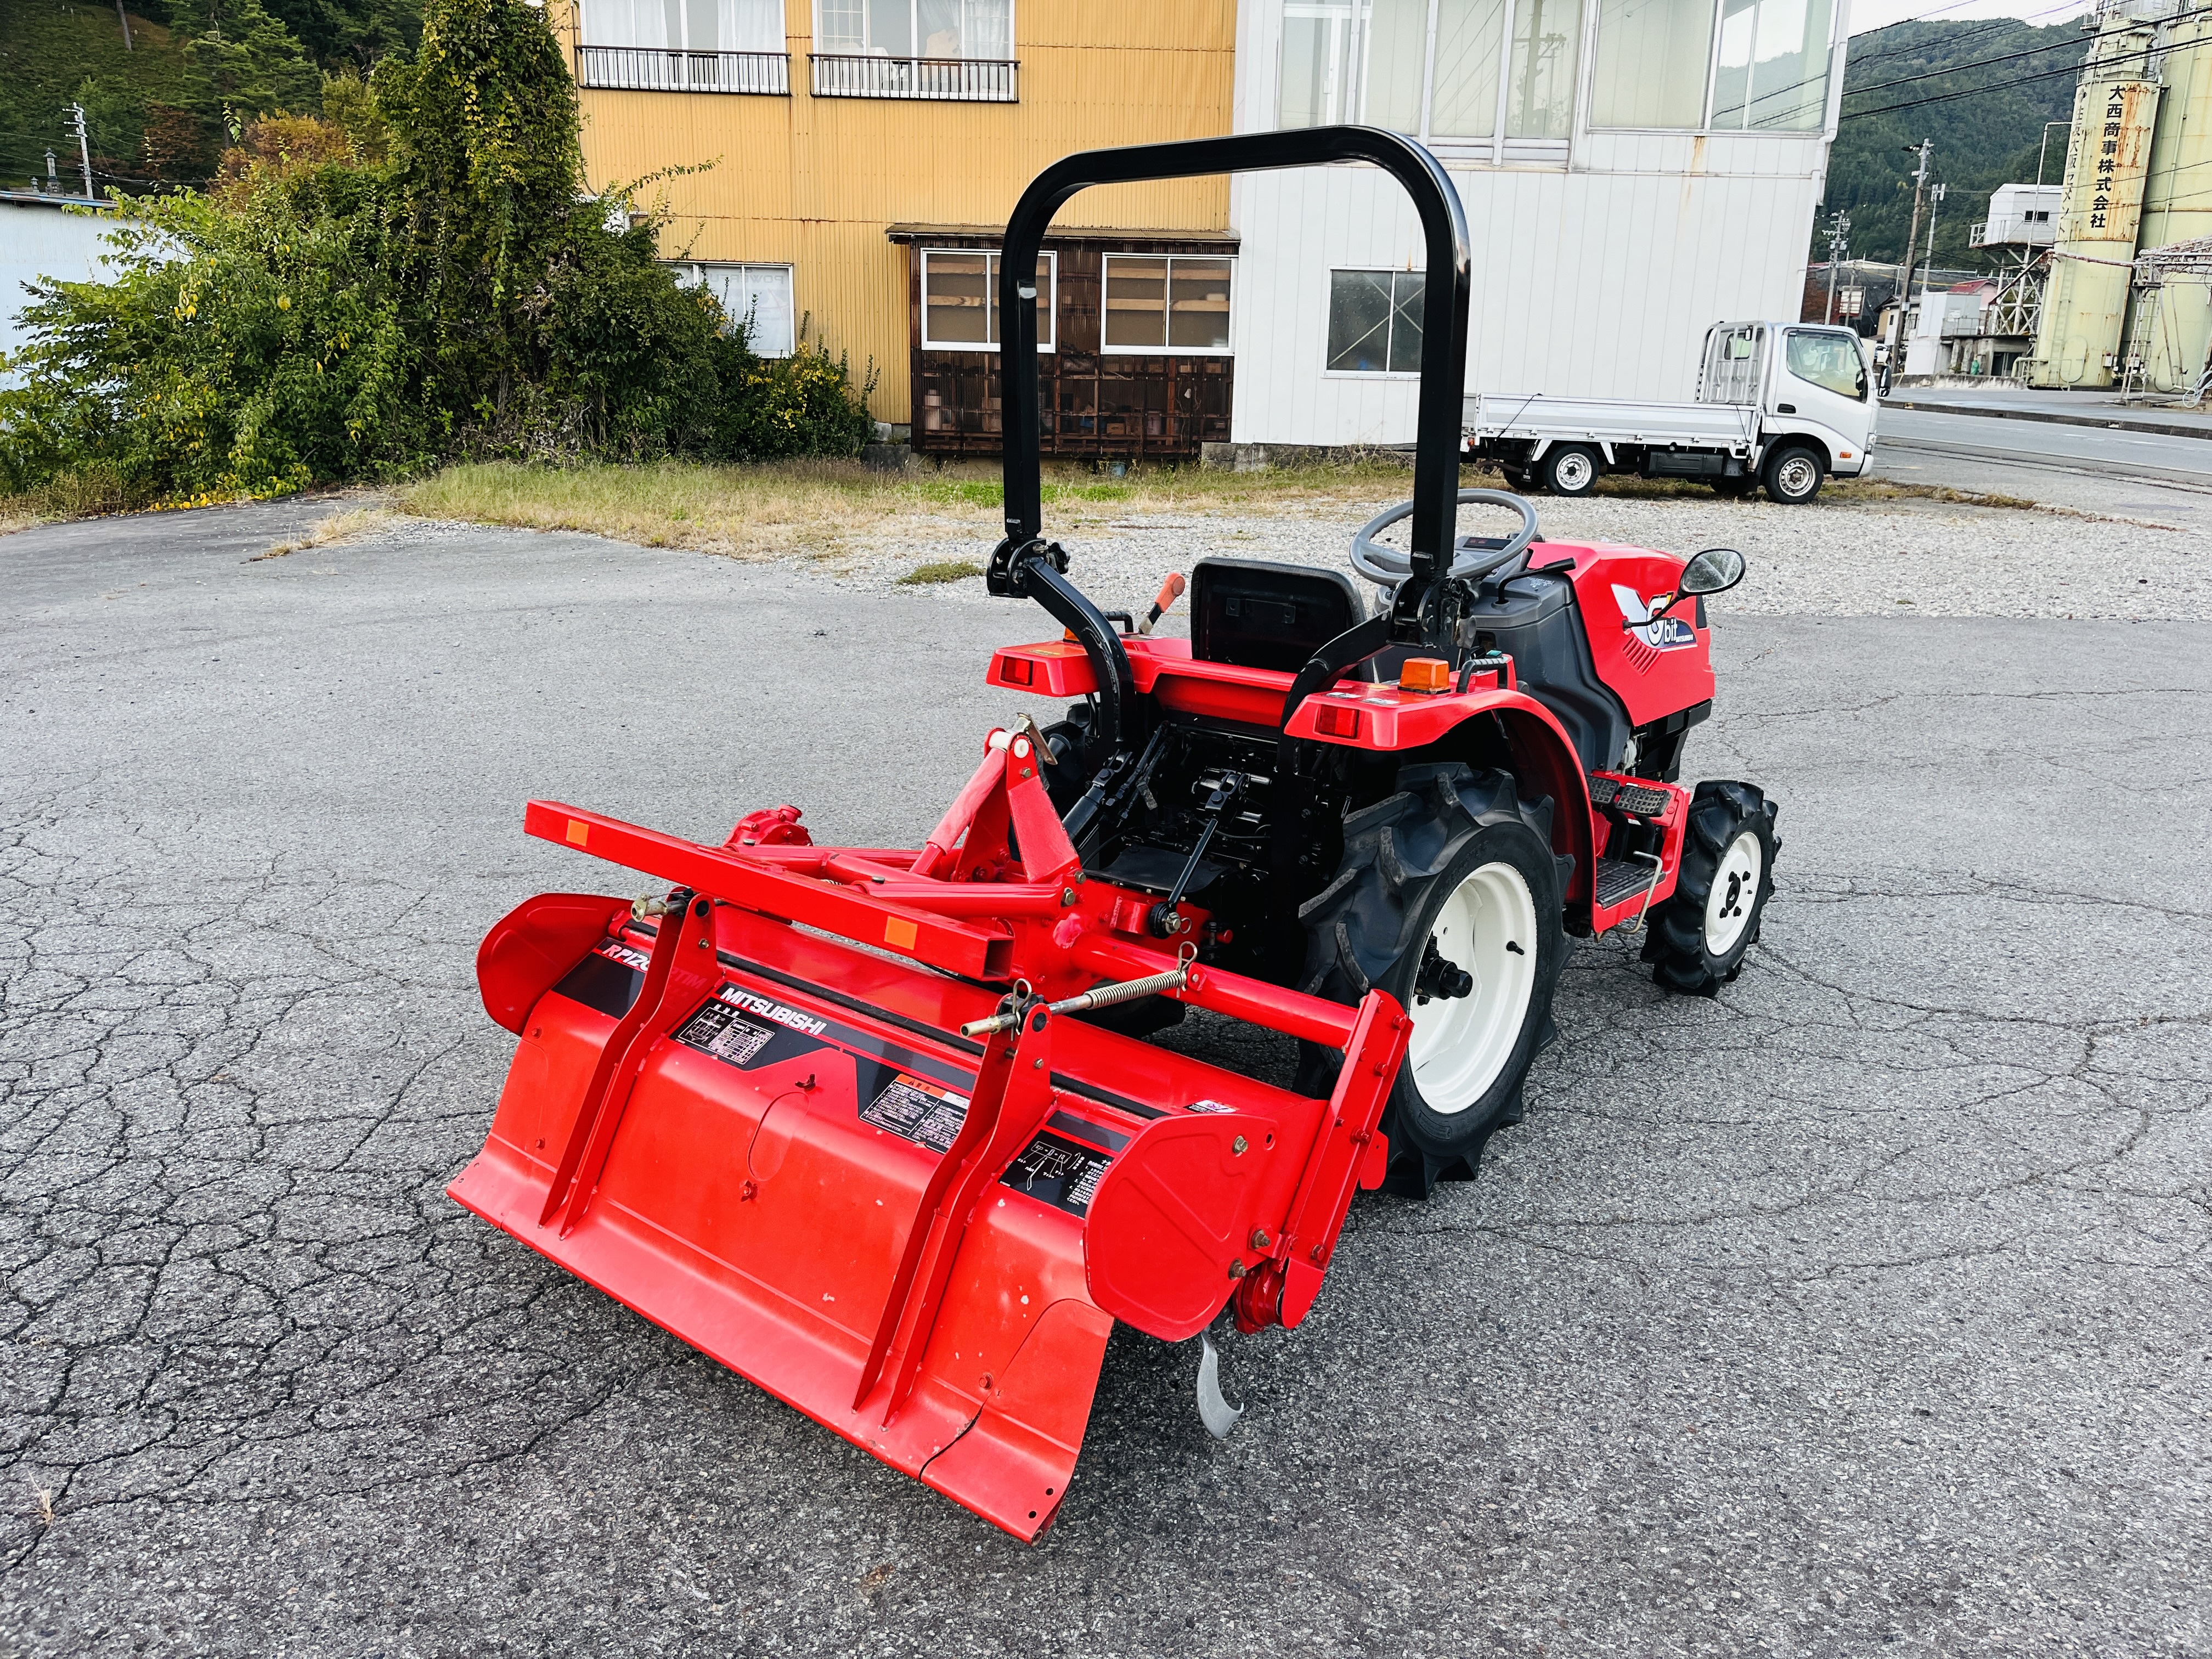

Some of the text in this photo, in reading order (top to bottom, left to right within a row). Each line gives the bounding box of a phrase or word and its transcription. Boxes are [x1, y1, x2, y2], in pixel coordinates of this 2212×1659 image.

[2090, 84, 2126, 228] 大西商事株式会社
[719, 987, 827, 1036] MITSUBISHI
